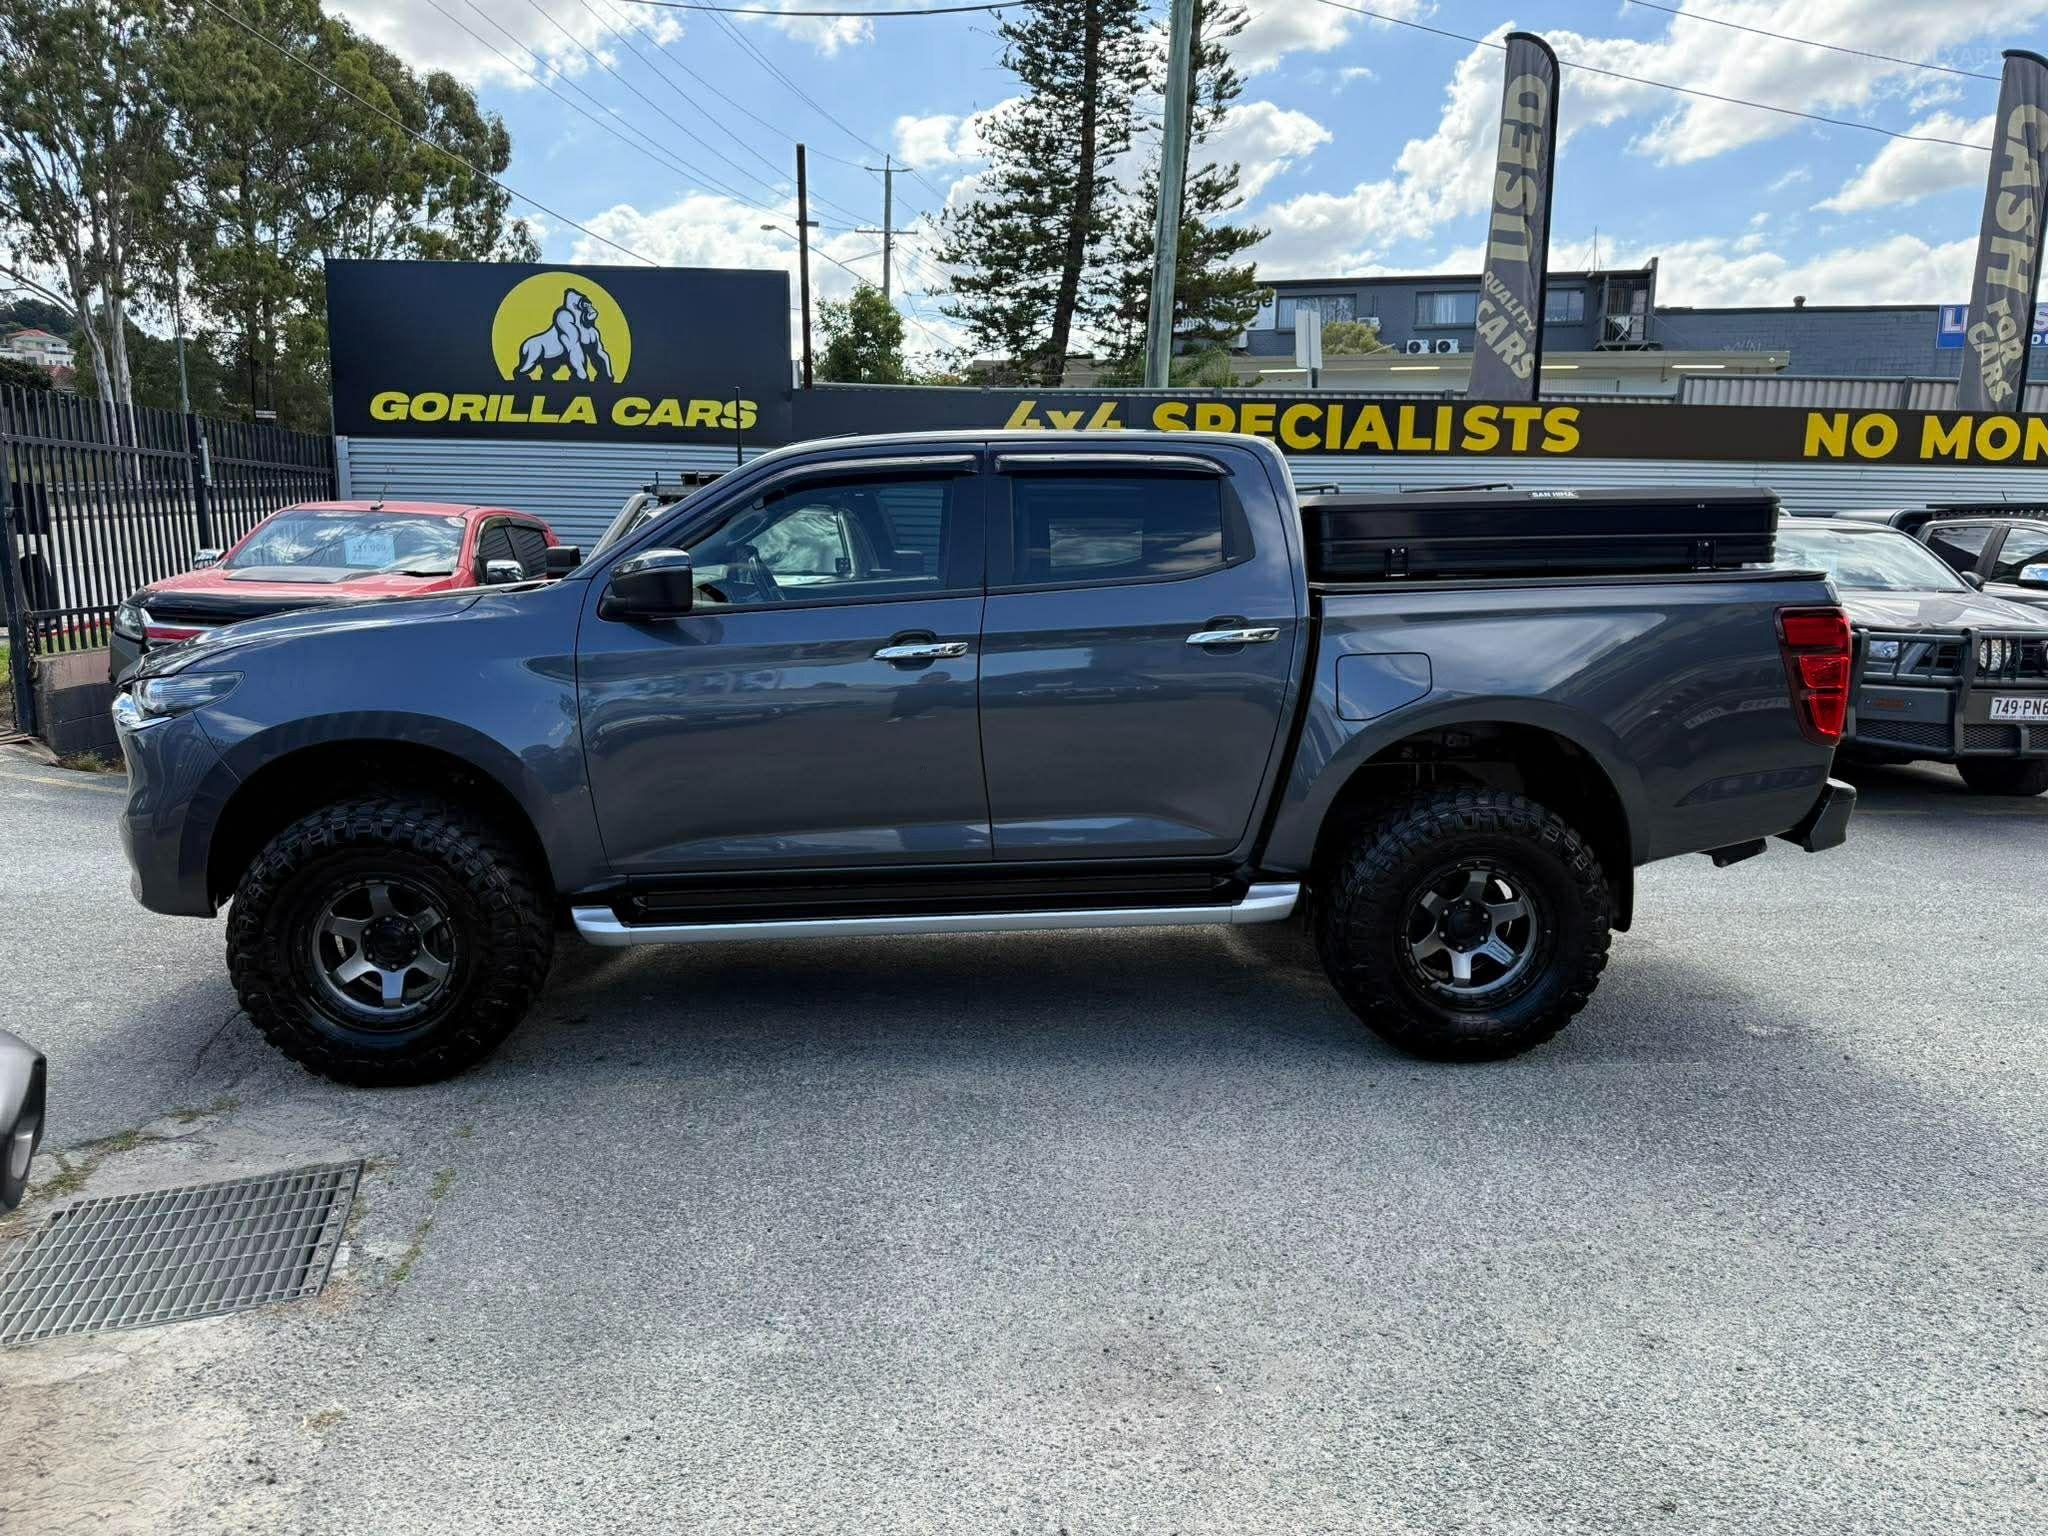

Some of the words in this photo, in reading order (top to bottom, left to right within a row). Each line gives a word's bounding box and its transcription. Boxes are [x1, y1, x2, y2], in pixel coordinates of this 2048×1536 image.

[1490, 73, 1548, 262] USED
[1986, 104, 2048, 294] CASH
[1484, 270, 1537, 333] QUALITY
[1985, 297, 2024, 368] FOR
[1476, 299, 1536, 379] CARS
[1966, 321, 2014, 402] CARS
[369, 391, 598, 426] GORILLA
[611, 397, 758, 431] CARS
[1003, 400, 1124, 430] 4x4
[1152, 402, 1581, 454] SPECIALISTS
[1803, 412, 1899, 460] NO
